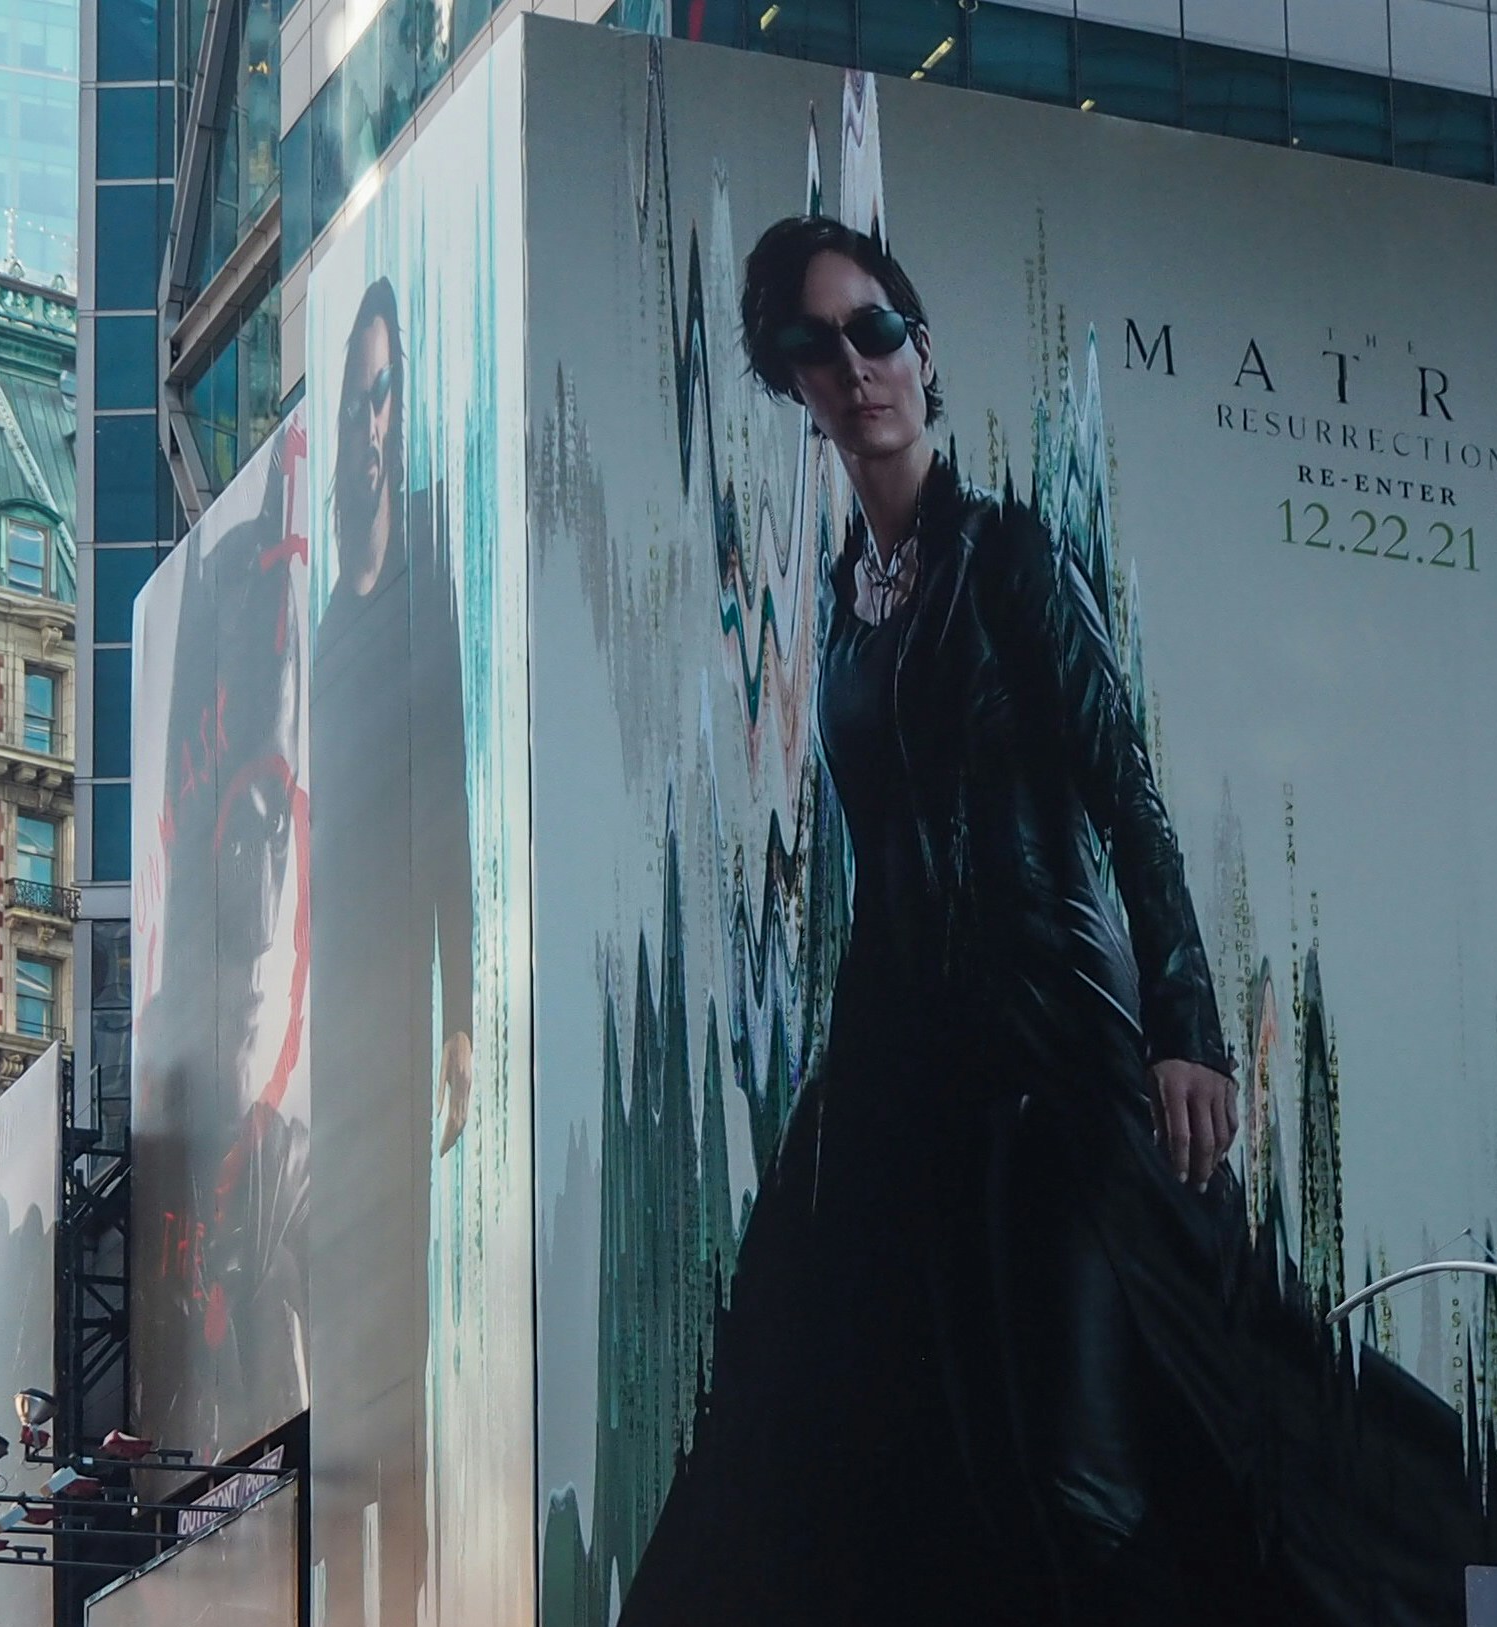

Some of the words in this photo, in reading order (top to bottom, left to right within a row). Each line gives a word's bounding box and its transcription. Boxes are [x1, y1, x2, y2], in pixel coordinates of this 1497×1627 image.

[1327, 327, 1418, 356] THE
[1297, 464, 1458, 507] RE-ENTER
[1276, 498, 1481, 573] 12.22.21
